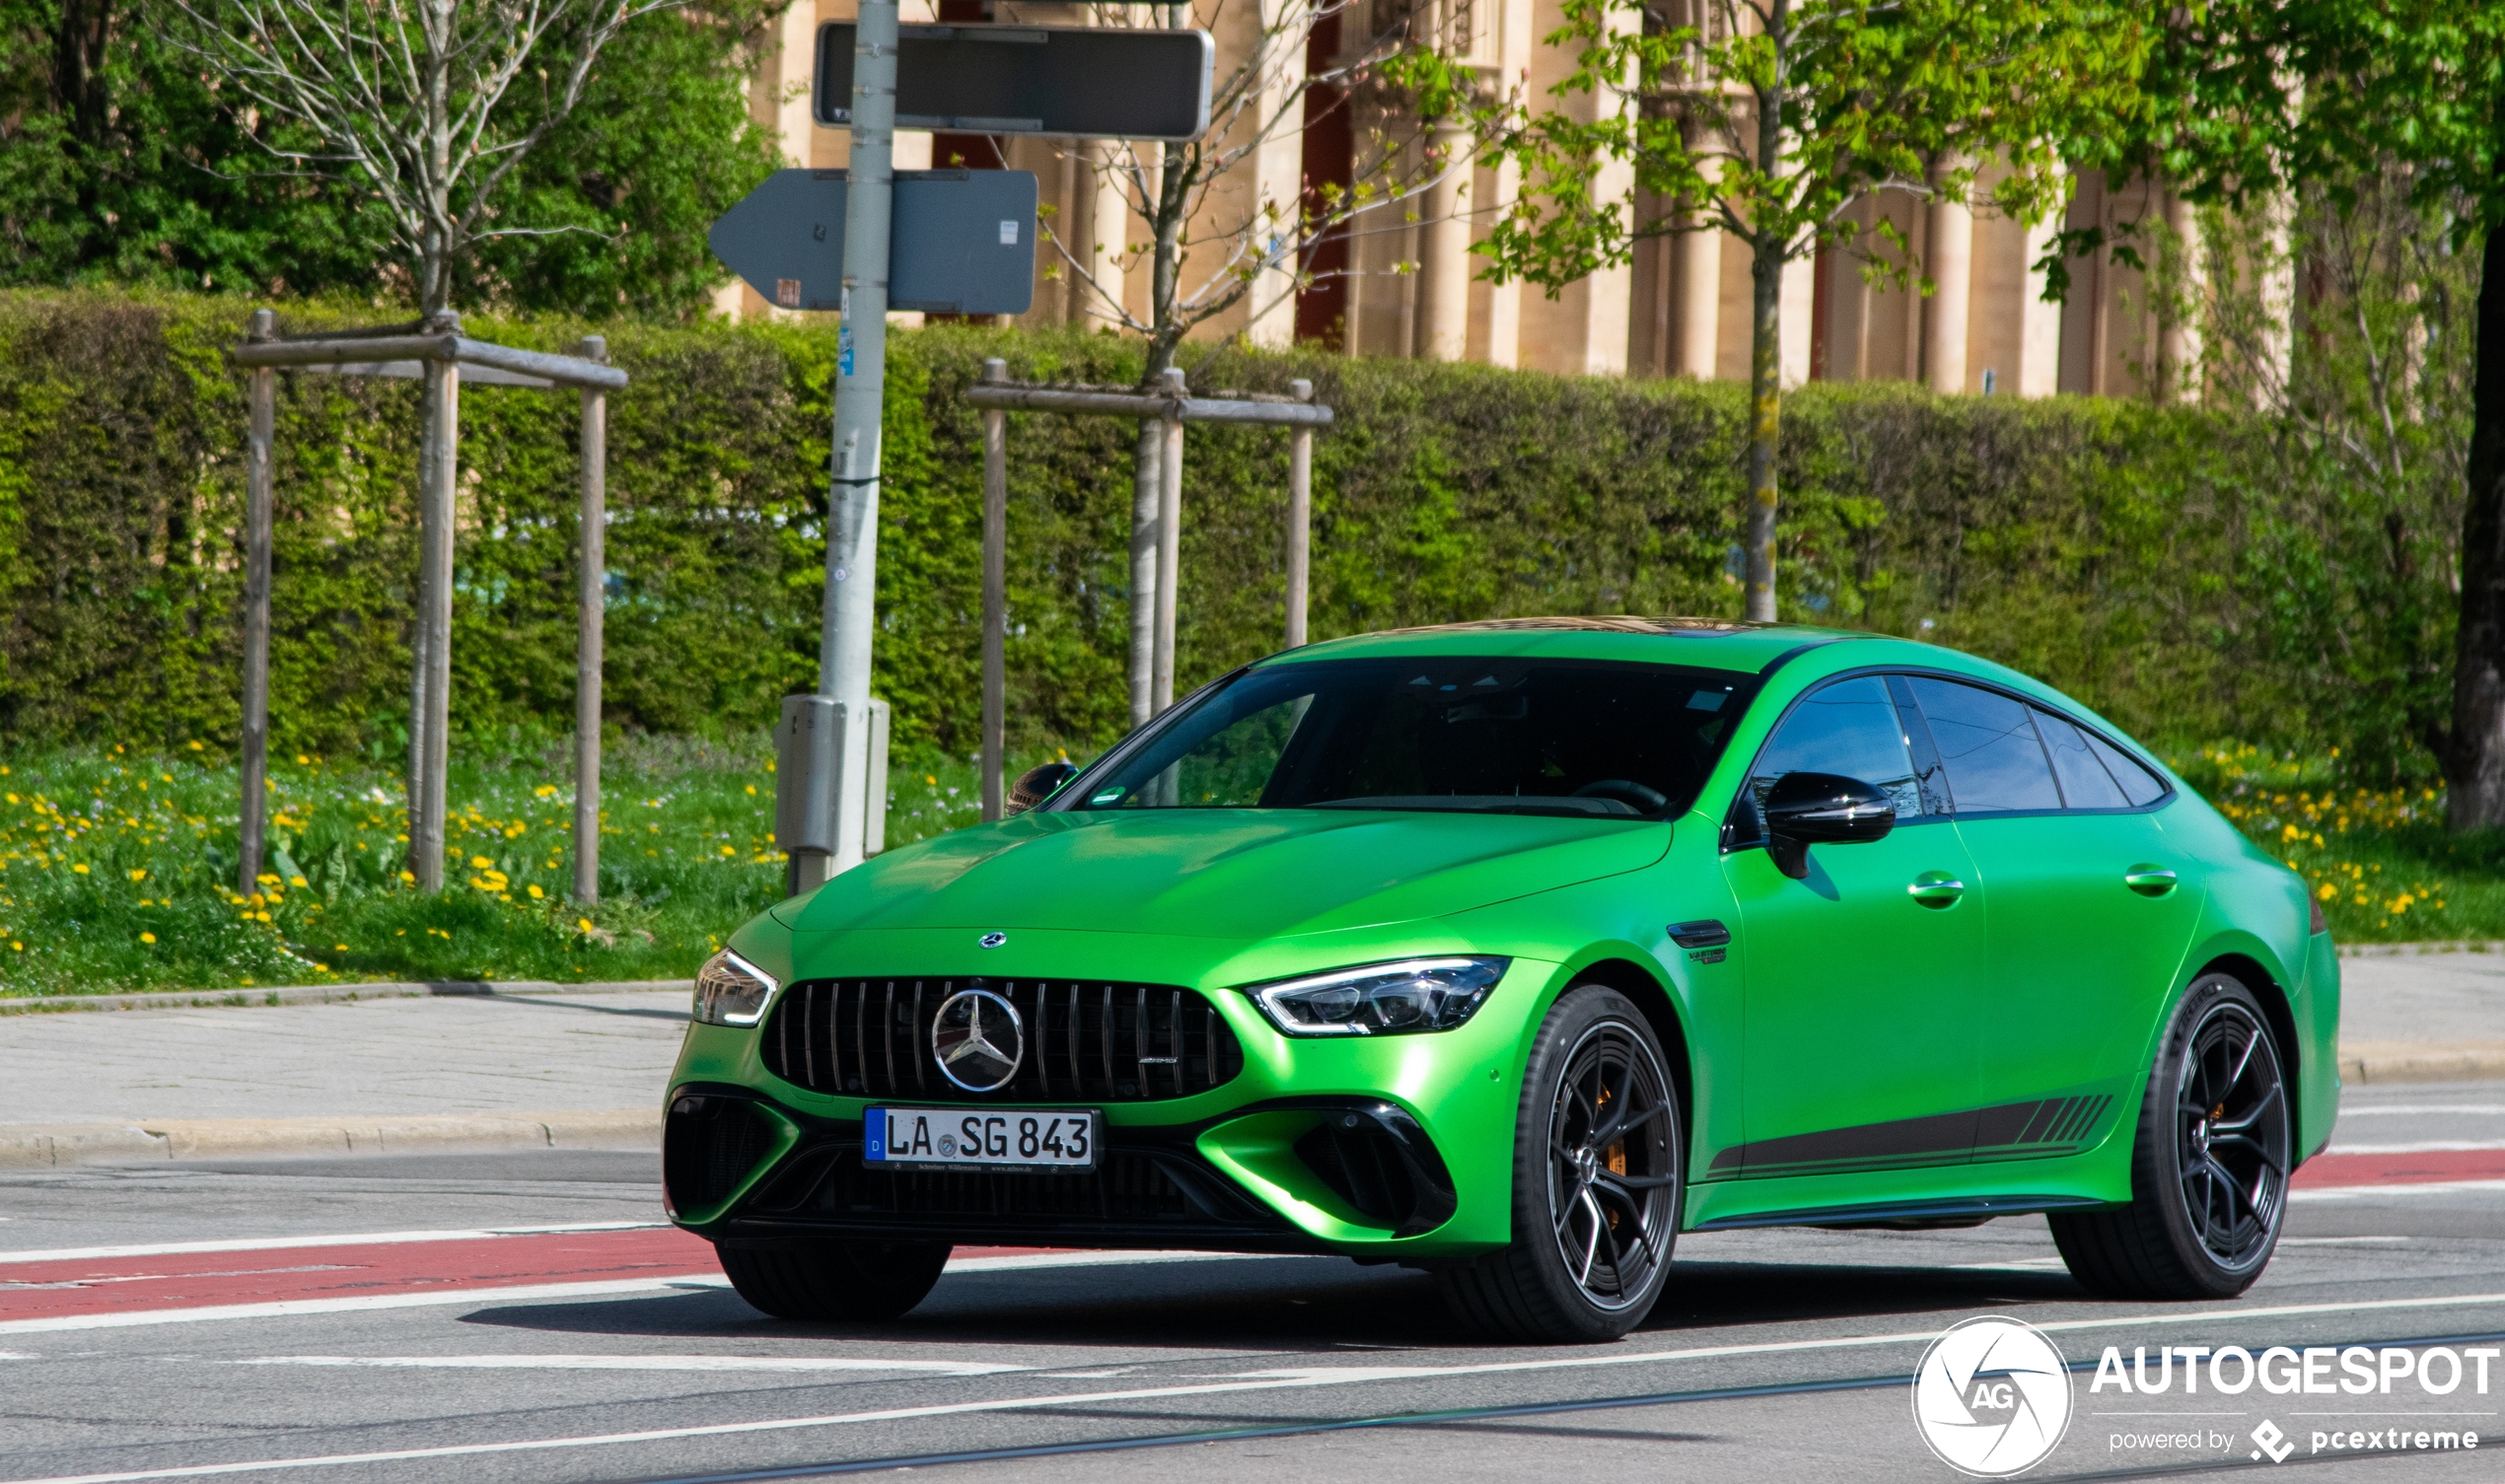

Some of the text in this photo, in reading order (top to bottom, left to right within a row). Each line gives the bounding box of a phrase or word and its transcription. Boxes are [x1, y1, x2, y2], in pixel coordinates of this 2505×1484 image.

[872, 1140, 880, 1152] D
[888, 1115, 1089, 1159] LA SG 843
